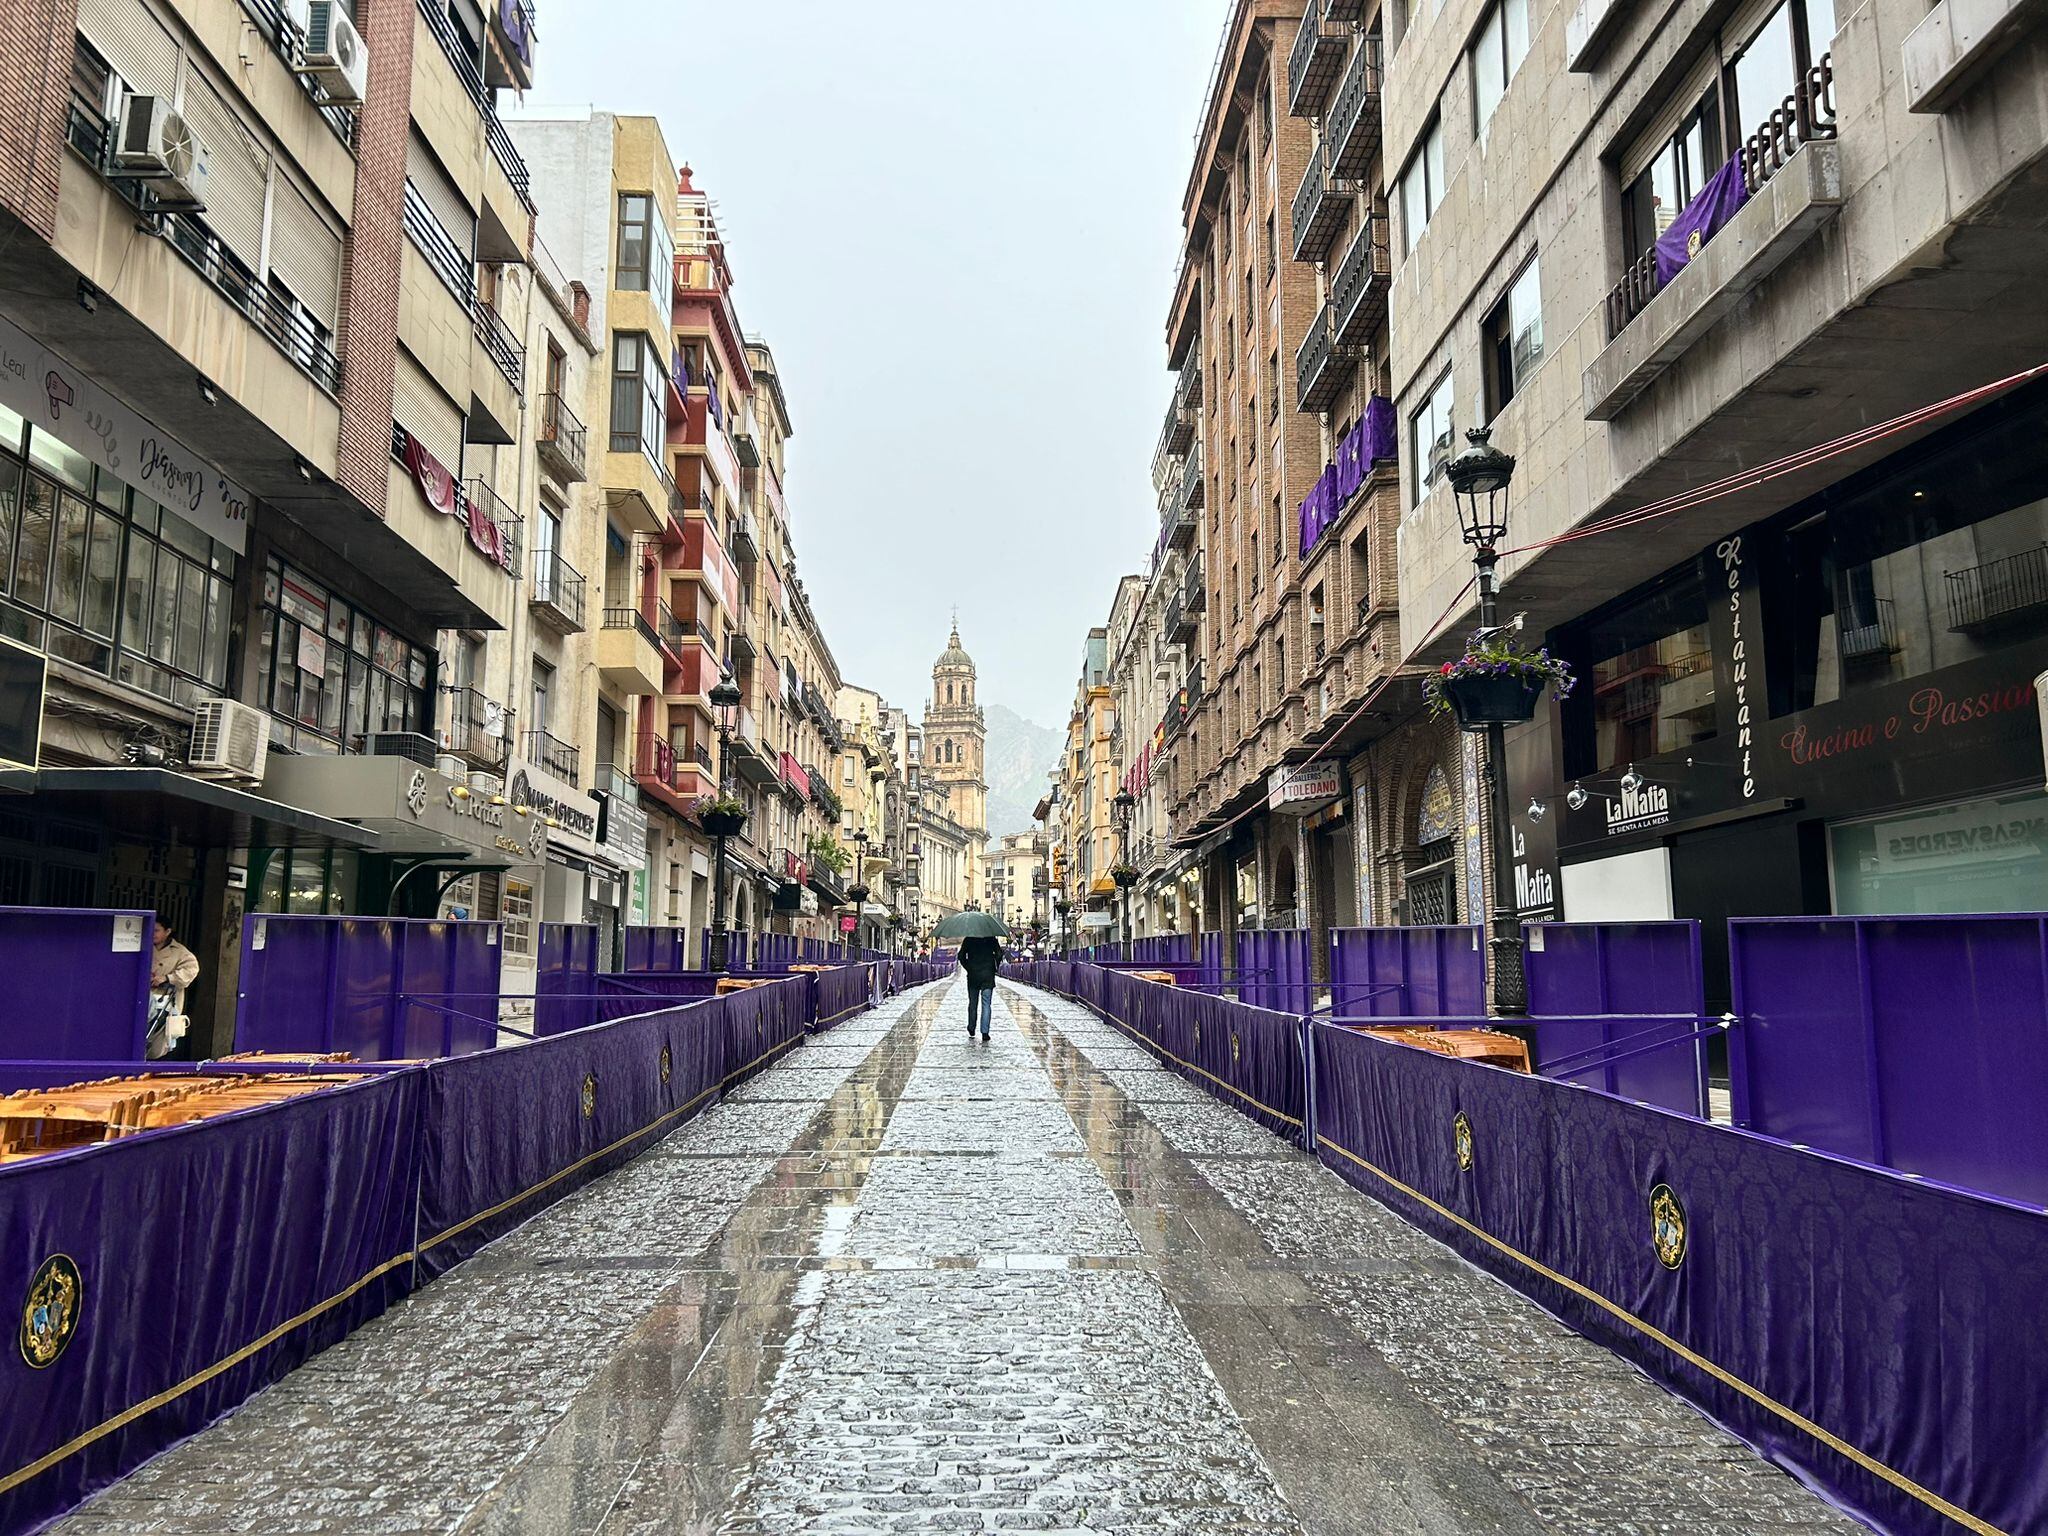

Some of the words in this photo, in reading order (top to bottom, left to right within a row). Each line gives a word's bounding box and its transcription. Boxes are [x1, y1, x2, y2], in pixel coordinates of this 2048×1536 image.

[1716, 536, 1755, 798] Restaurante
[1781, 725, 1873, 765] Cucina
[1884, 716, 1900, 740] e
[1288, 780, 1336, 797] TOLEDANO
[1512, 824, 1525, 858] La
[1616, 823, 1637, 834] SIENTA
[1642, 820, 1652, 828] LA
[1652, 816, 1670, 826] MESA
[1514, 863, 1554, 909] Mafia
